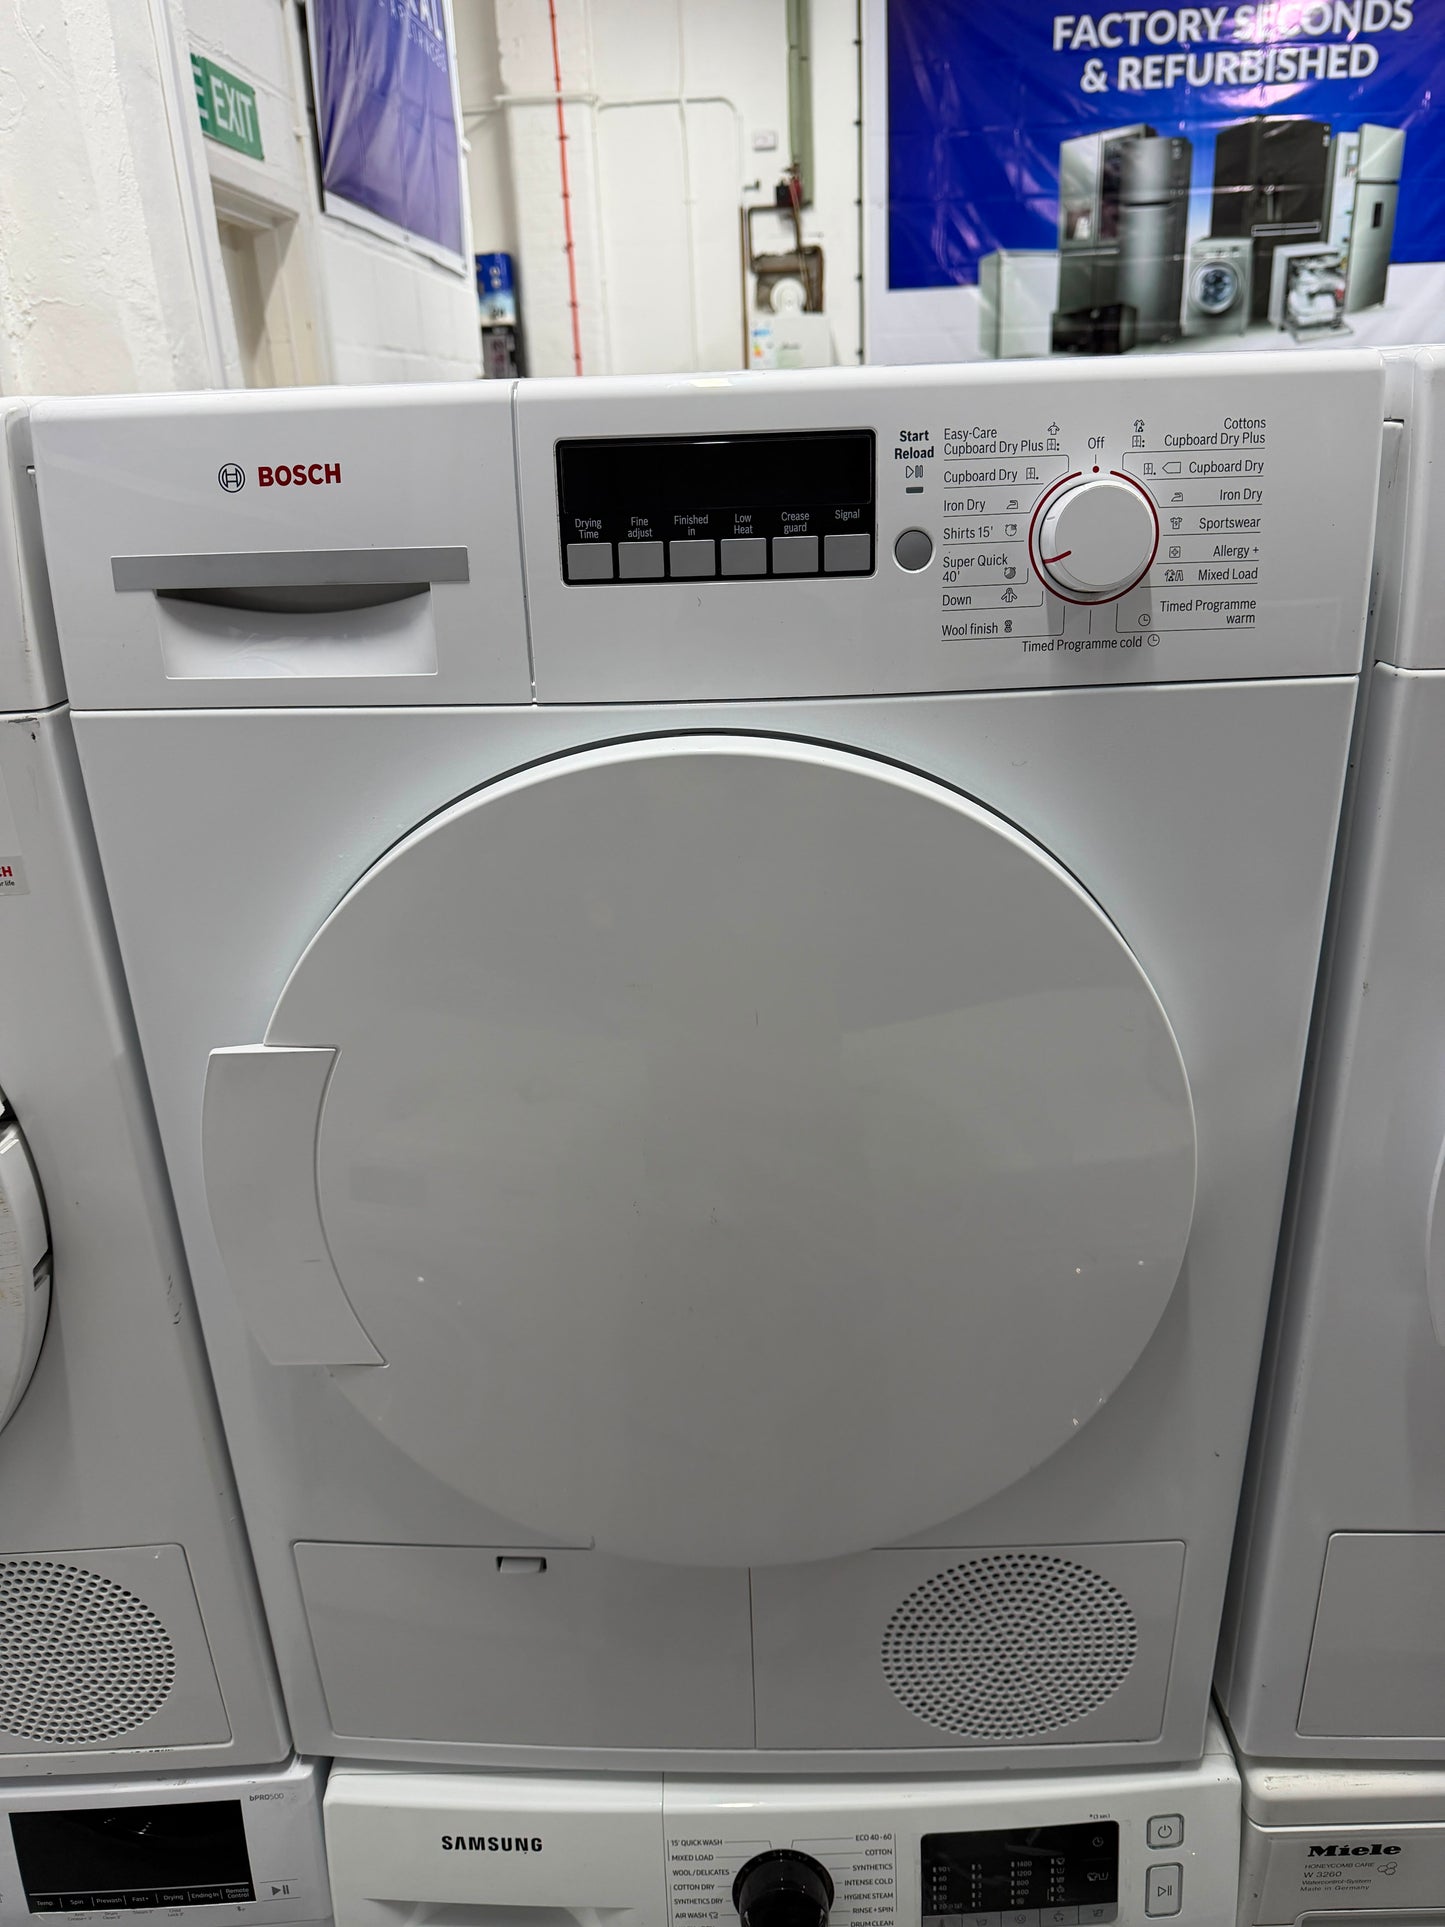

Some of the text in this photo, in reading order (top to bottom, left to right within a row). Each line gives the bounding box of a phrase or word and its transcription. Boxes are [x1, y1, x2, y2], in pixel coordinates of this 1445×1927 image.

[1053, 8, 1227, 51] FACTORY
[1080, 43, 1380, 94] & REFURBISHED
[210, 74, 254, 143] EXIT
[1224, 417, 1266, 429] Cottons
[900, 430, 930, 442] Start
[944, 426, 997, 442] Easy-Care
[1164, 431, 1266, 448] Cupboard Dry Plus
[944, 439, 1044, 456] Cupboard Dry Plus
[1087, 436, 1105, 449] Off
[894, 445, 935, 460] Reload
[1188, 460, 1264, 474] Cupboard Dry
[257, 463, 342, 487] BOSCH
[943, 469, 1018, 484] Cupboard Dry
[1219, 488, 1263, 501] Iron Dry
[943, 499, 986, 512] Iron Dry
[674, 514, 709, 525] Finished
[734, 513, 752, 523] Low
[781, 511, 810, 521] Crease
[834, 508, 860, 521] Signal
[574, 518, 602, 530] Drying
[630, 516, 649, 527] Fine
[1199, 517, 1261, 531] Sportswear
[578, 529, 599, 539] Time
[627, 528, 653, 539] adjust
[687, 526, 696, 537] in
[733, 524, 754, 535] Heat
[783, 522, 808, 535] guard
[943, 526, 993, 540] Shirts 15'
[1213, 545, 1250, 559] Allergy
[942, 553, 1008, 570] Super Quick
[942, 570, 960, 583] 40'
[1198, 567, 1258, 581] Mixed Load
[942, 594, 972, 606] Down
[1160, 599, 1257, 613] Timed Programme
[1226, 614, 1256, 624] warm
[942, 621, 999, 636] Wool finish
[1022, 636, 1142, 652] Timed Programme cold
[441, 1835, 544, 1852] SAMSUNG
[1307, 1844, 1402, 1857] Miele
